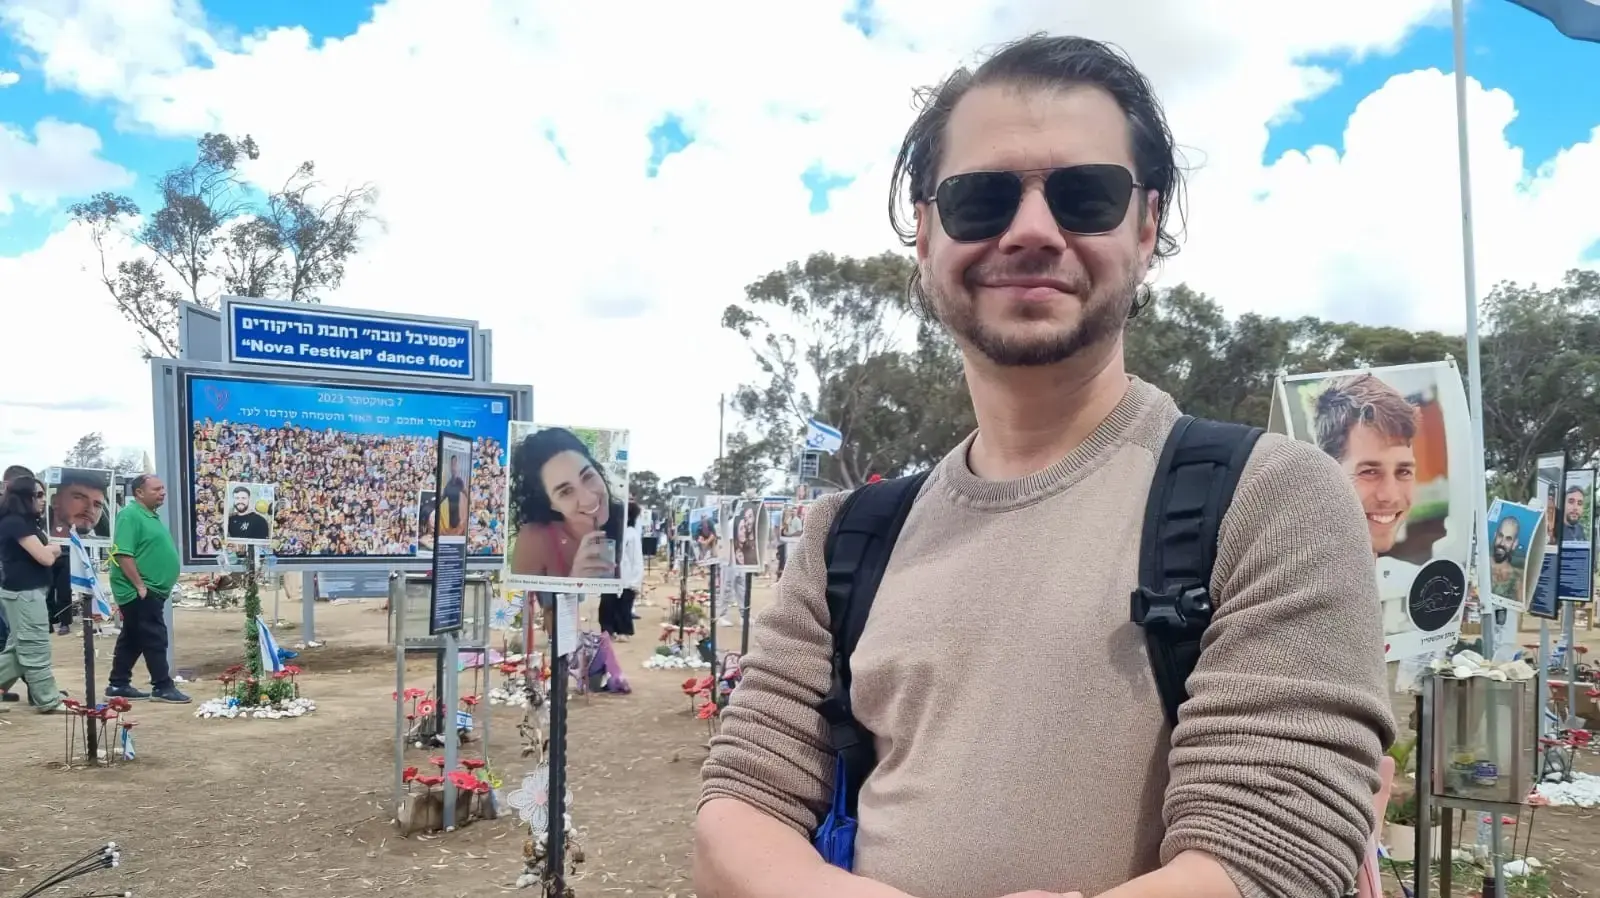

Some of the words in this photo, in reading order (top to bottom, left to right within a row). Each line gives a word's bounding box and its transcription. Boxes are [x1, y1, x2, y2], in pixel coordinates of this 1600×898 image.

[242, 317, 313, 335] הריקודים
[318, 324, 358, 340] רחבת
[241, 339, 294, 354] “Nova
[299, 343, 372, 360] Festival”
[376, 350, 424, 365] dance
[429, 354, 464, 368] floor
[317, 392, 344, 404] 2023
[397, 397, 403, 407] 7
[264, 409, 298, 418] שנדמו
[302, 411, 345, 421] והשמחה
